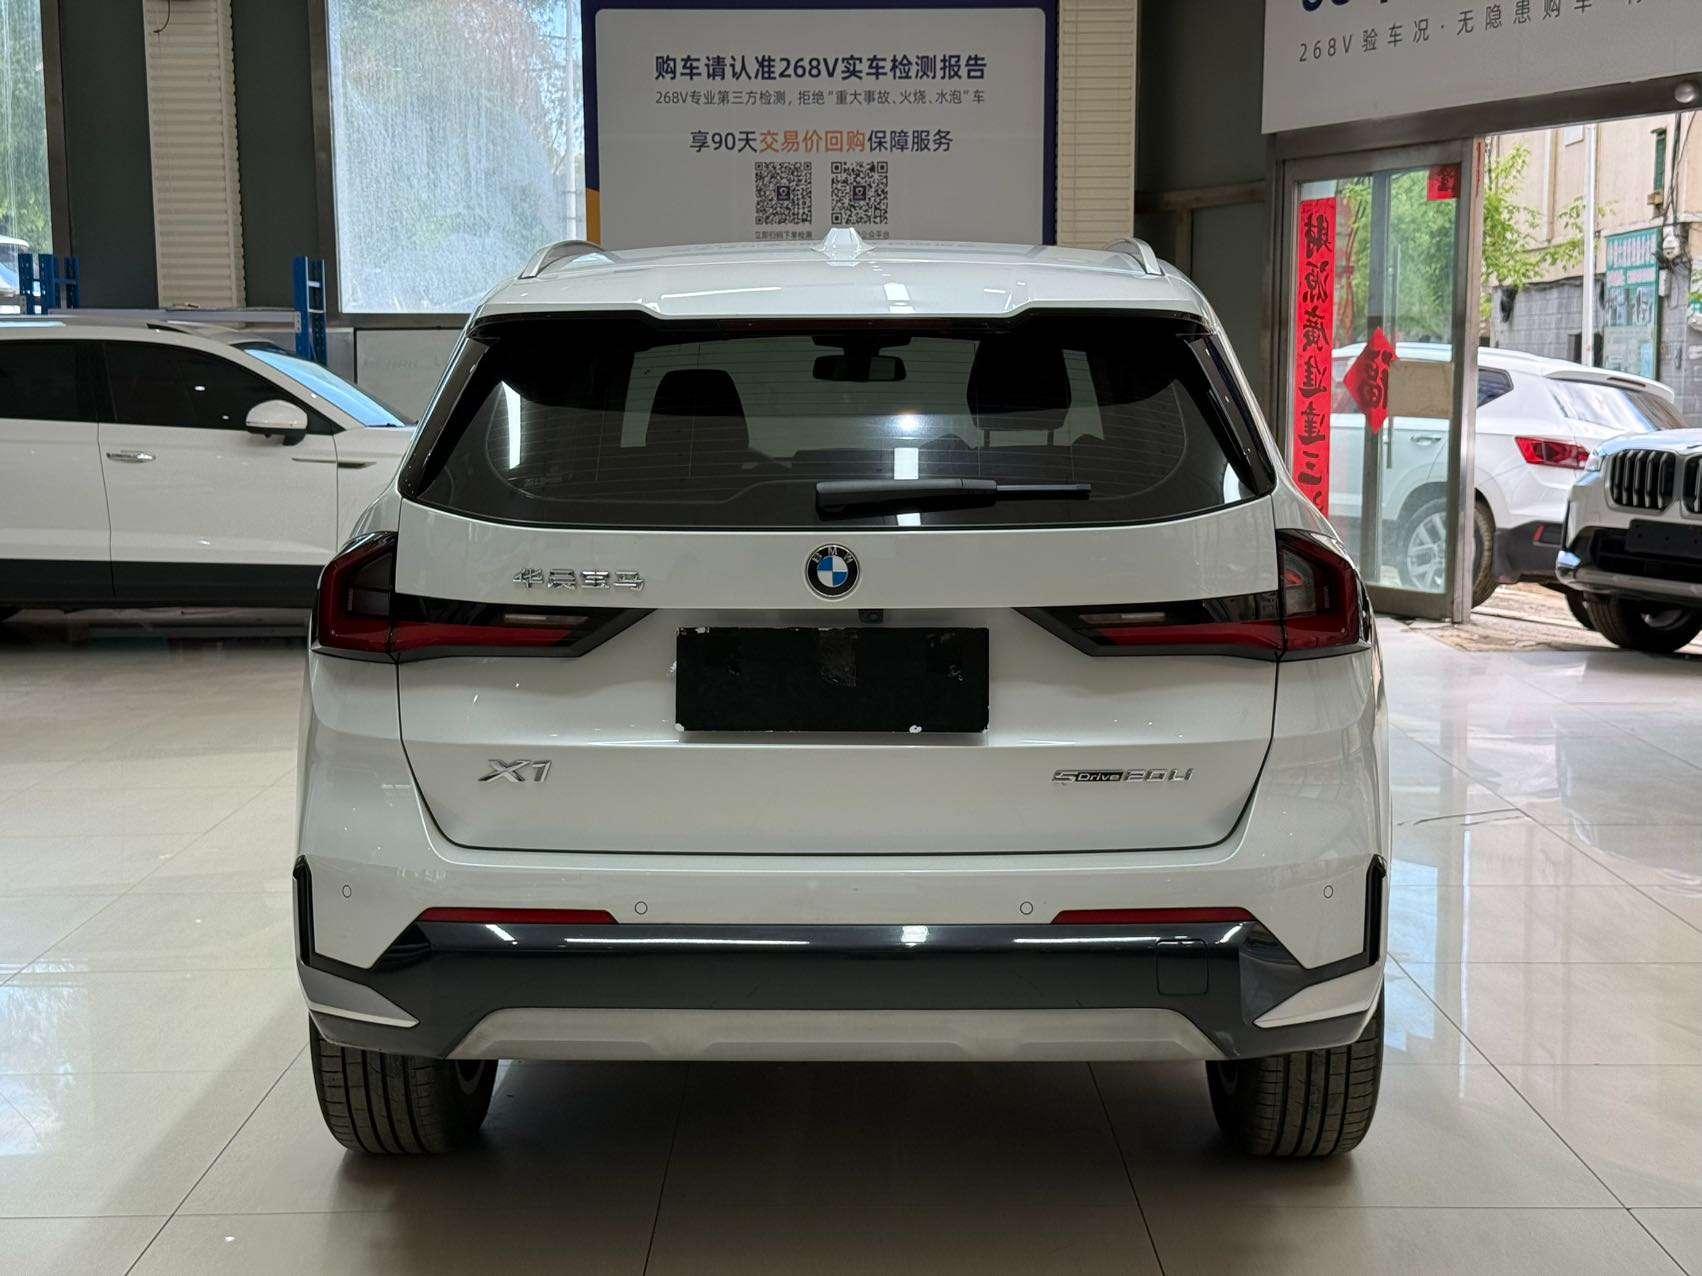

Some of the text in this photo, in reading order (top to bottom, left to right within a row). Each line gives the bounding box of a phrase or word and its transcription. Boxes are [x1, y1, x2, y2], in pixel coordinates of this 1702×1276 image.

[655, 54, 987, 81] 购车请认准268V实车检测报告
[689, 130, 954, 153] 享90天交易价回购保障服务
[811, 546, 855, 564] BMW
[512, 567, 645, 592] 华晨宝马
[478, 759, 552, 783] X1
